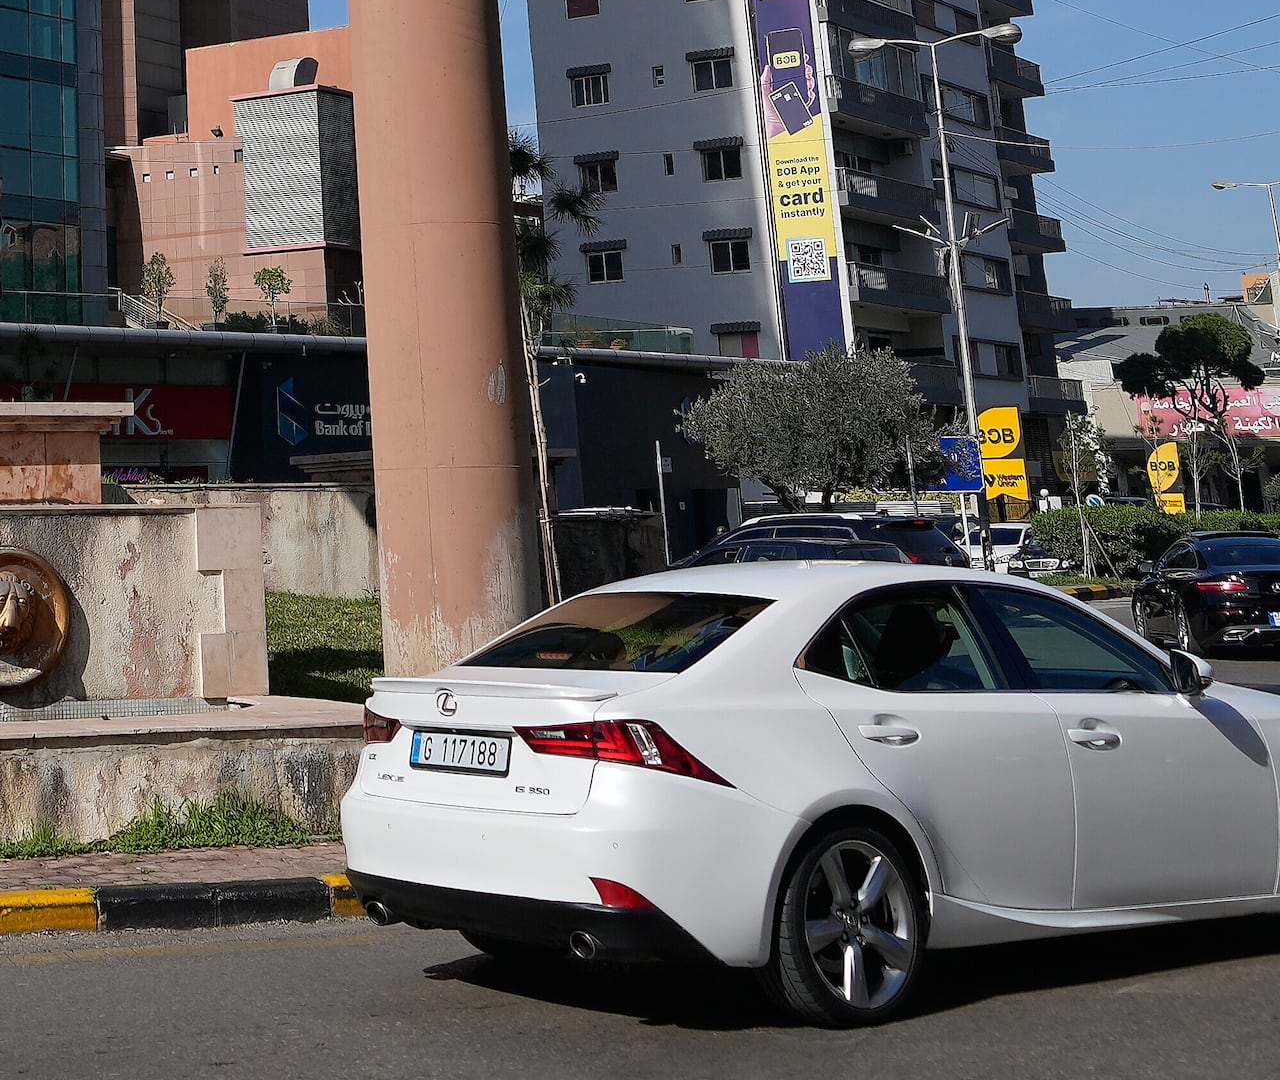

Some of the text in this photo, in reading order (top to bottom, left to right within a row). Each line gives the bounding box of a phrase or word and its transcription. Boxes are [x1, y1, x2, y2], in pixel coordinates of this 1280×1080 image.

[775, 157, 808, 166] Download
[777, 166, 820, 177] BOB App
[778, 178, 821, 189] & get your
[780, 187, 824, 207] card
[780, 207, 825, 219] instantly
[315, 403, 365, 419] بيروت
[315, 420, 348, 435] Bank
[349, 421, 364, 435] of
[998, 480, 1018, 488] Union
[424, 736, 497, 767] G 117188
